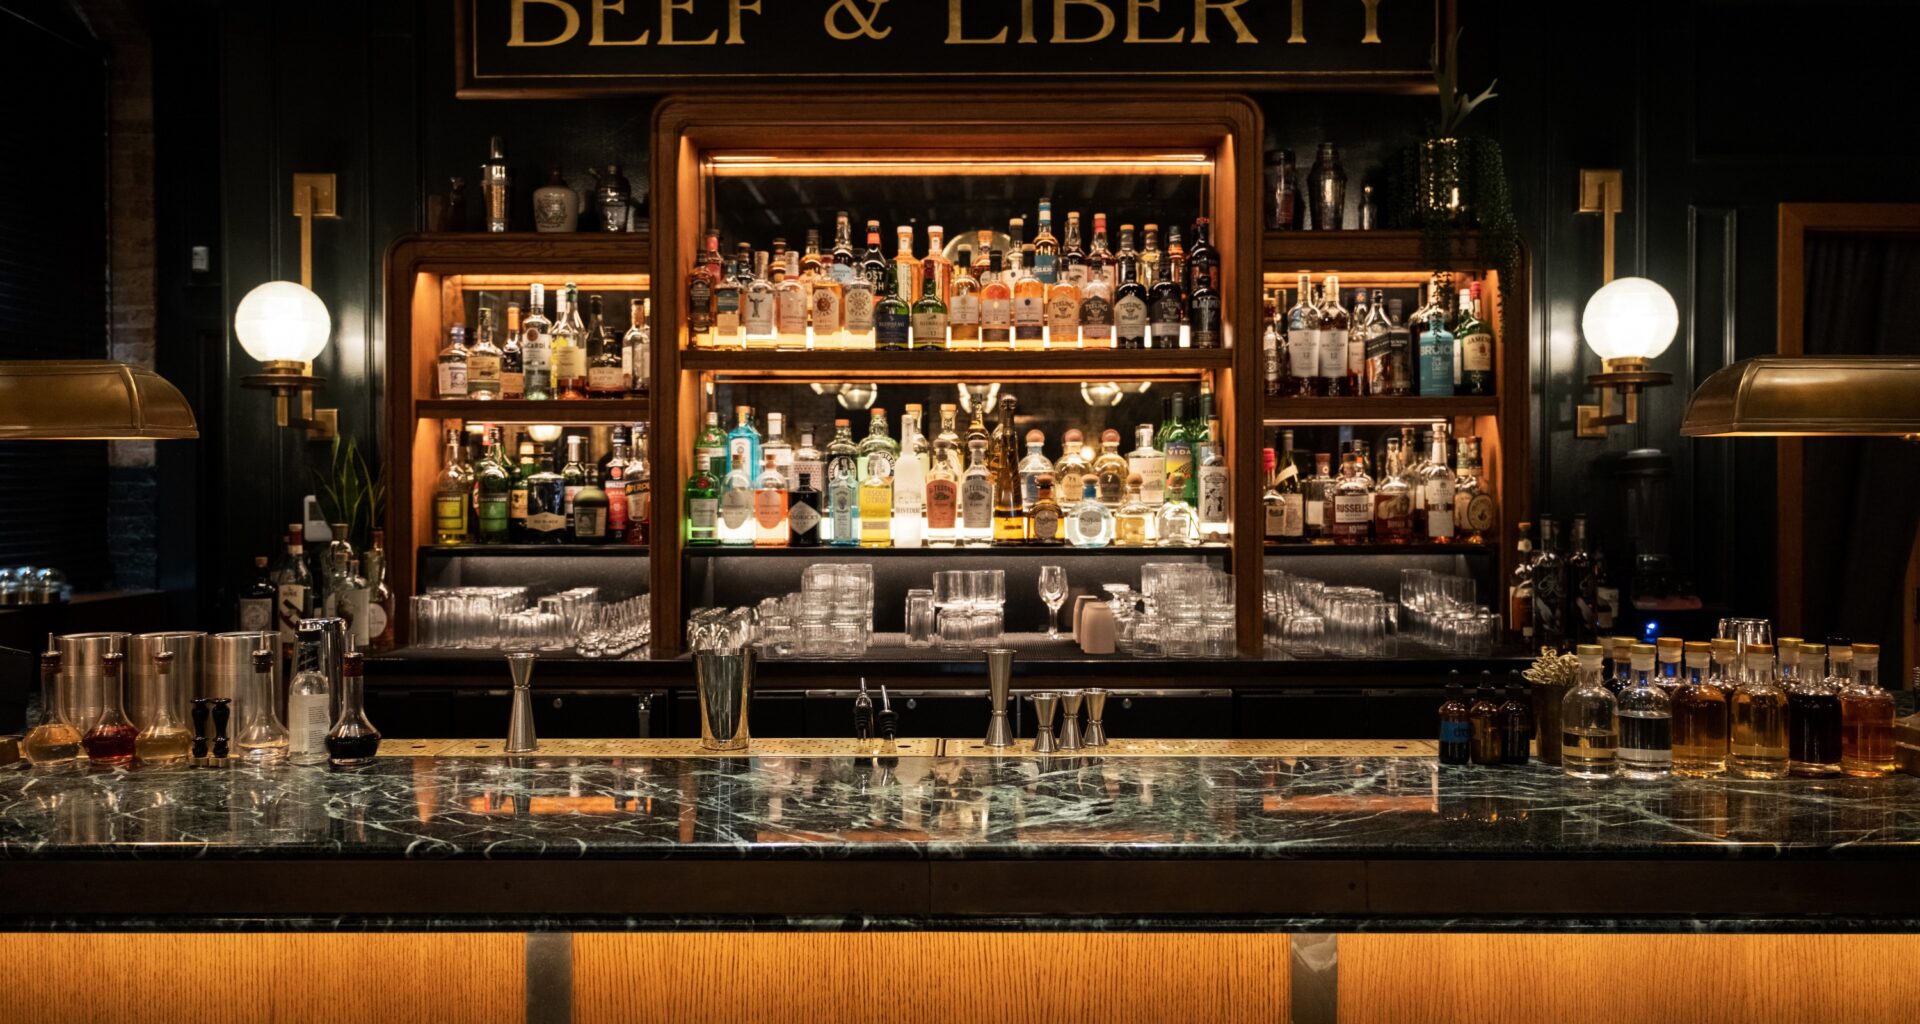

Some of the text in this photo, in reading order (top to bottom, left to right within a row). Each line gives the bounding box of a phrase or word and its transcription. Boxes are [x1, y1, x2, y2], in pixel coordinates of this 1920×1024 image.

[507, 0, 1383, 47] BEEF & LIBERTY
